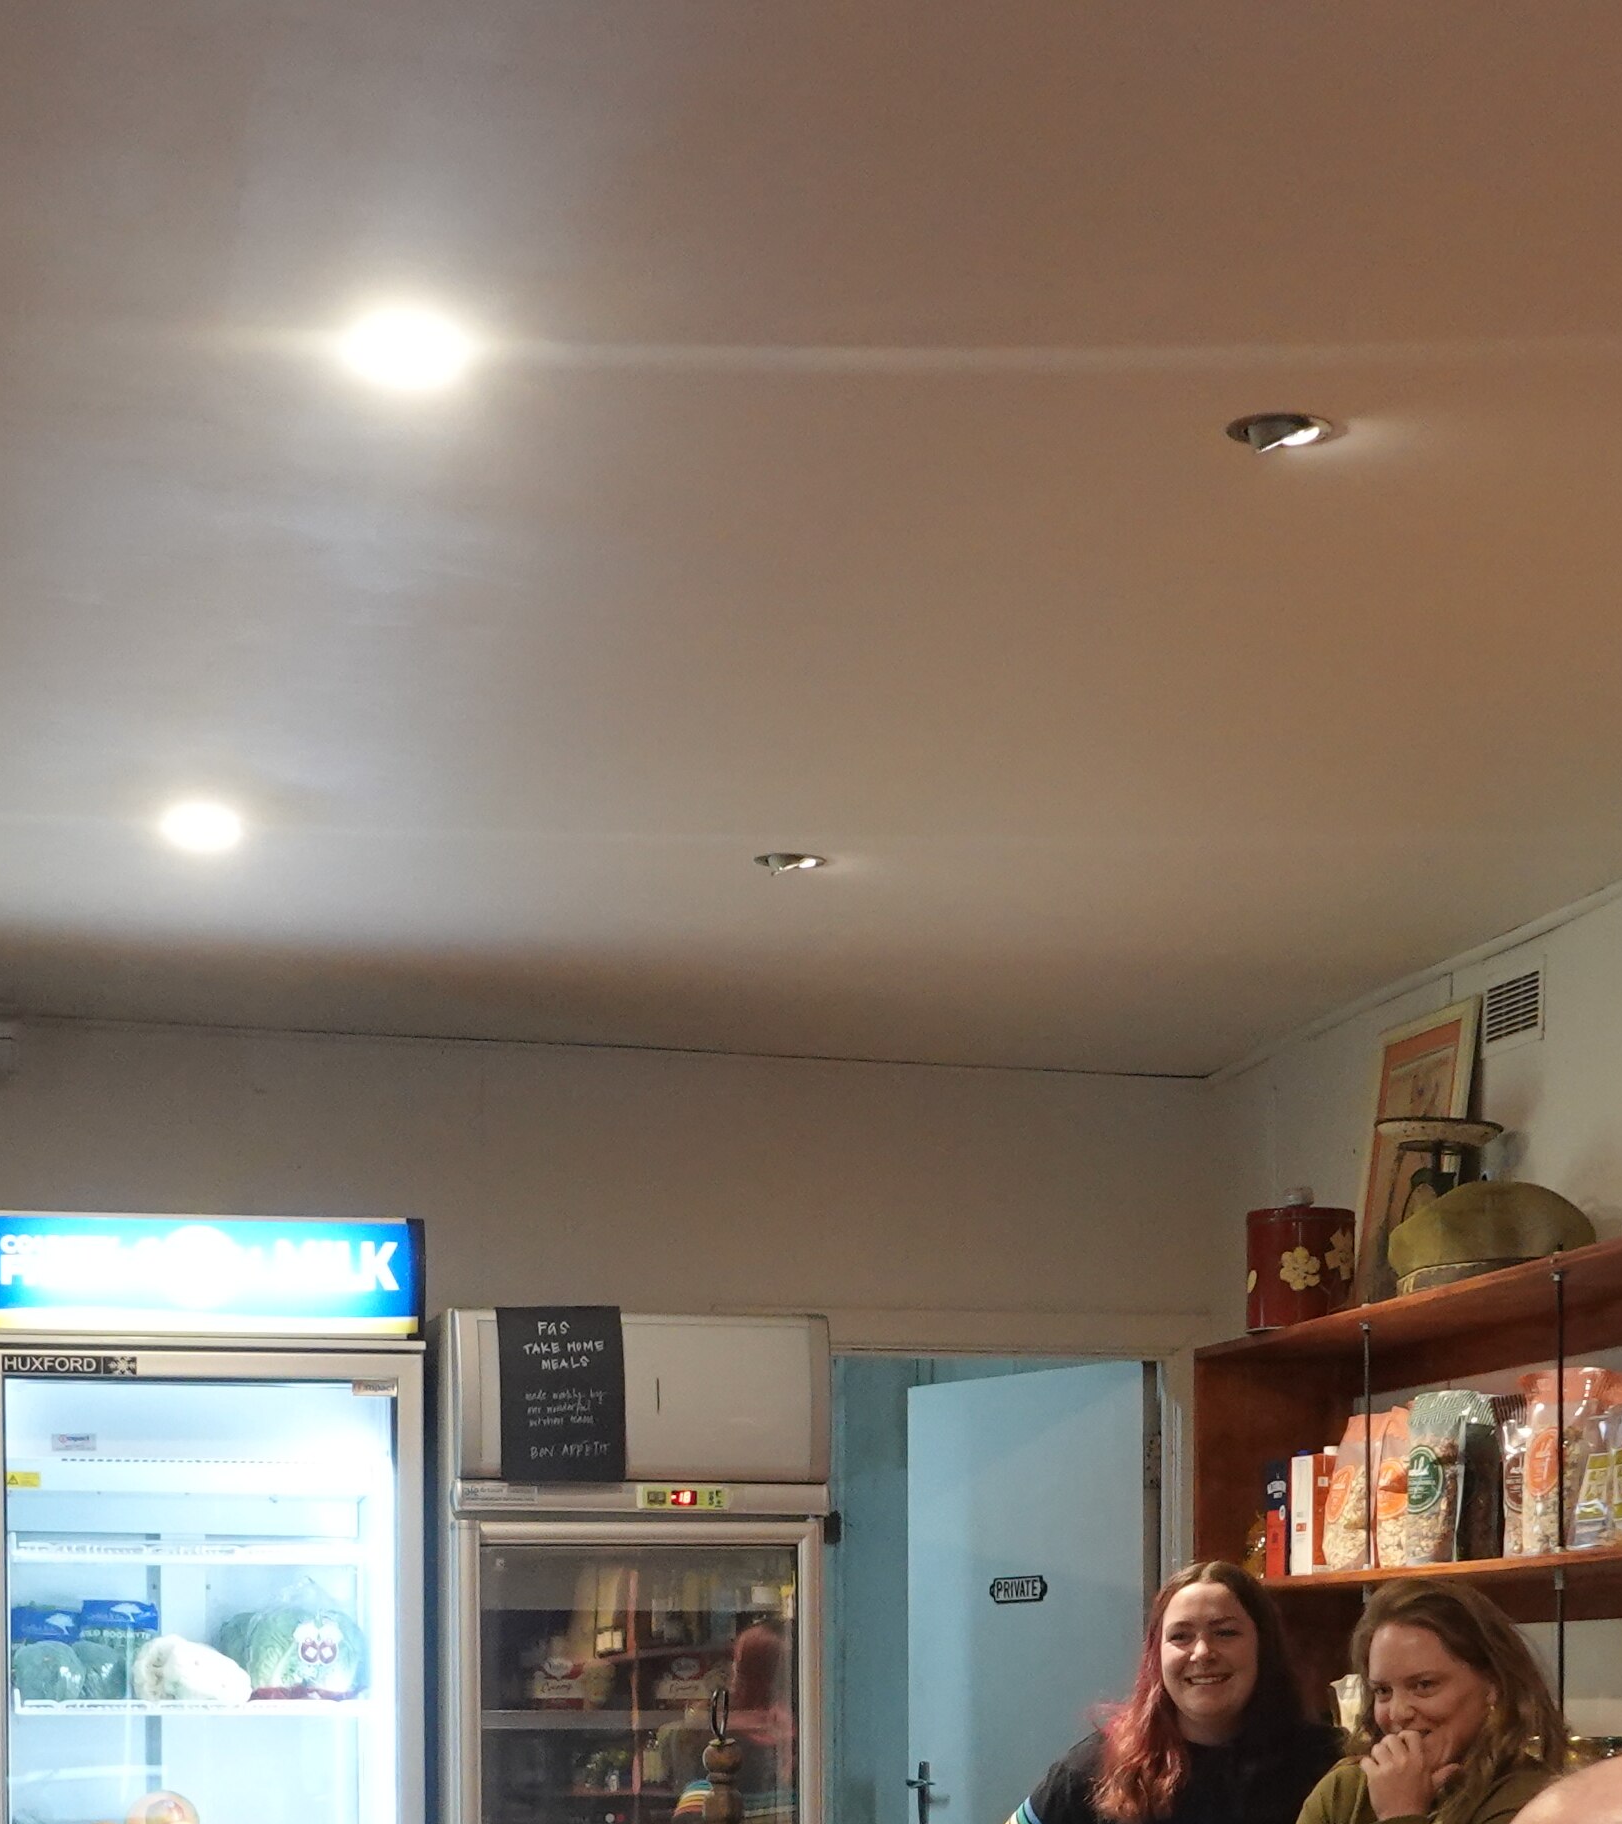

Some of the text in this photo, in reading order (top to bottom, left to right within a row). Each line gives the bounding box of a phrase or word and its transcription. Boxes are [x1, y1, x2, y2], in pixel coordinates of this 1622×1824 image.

[523, 1340, 605, 1355] TAKE HOME
[4, 1357, 97, 1373] HUXFORD
[540, 1355, 590, 1370] MEALS
[530, 1445, 556, 1459] BON
[996, 1580, 1039, 1599] PRIVATE
